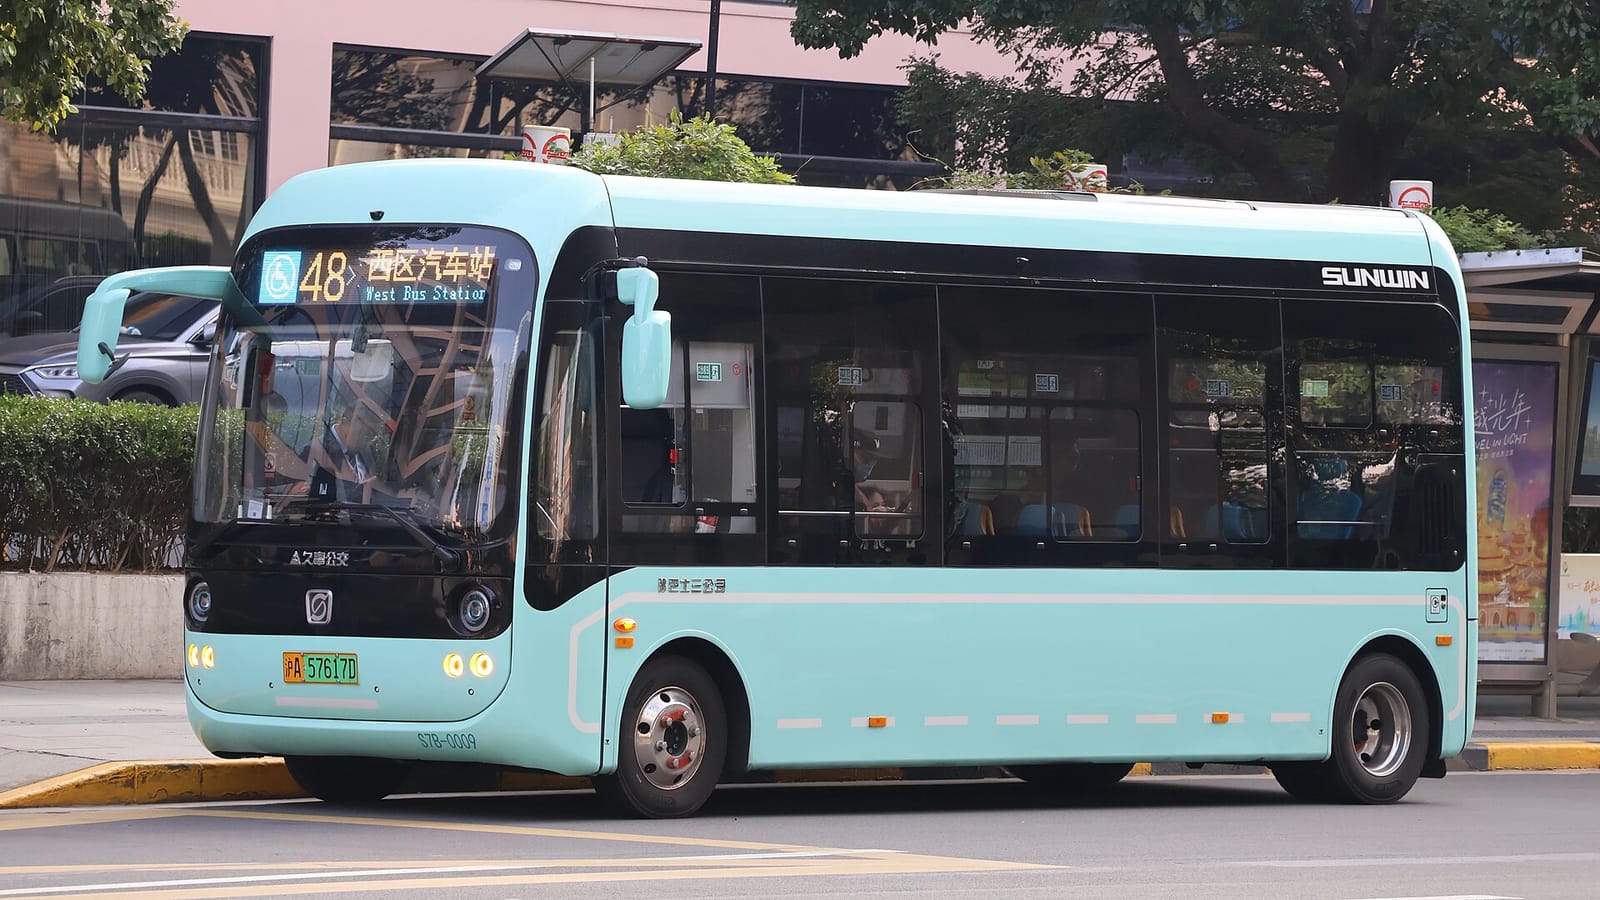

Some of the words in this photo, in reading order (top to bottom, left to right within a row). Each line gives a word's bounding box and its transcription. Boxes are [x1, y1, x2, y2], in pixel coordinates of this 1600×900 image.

[367, 246, 495, 283] 西区汽车站
[299, 251, 347, 302] 48
[1321, 267, 1429, 289] SUNWIN
[366, 286, 396, 301] West
[403, 285, 427, 301] Bus
[307, 657, 357, 680] 57617D
[417, 733, 477, 750] S7B-0009
